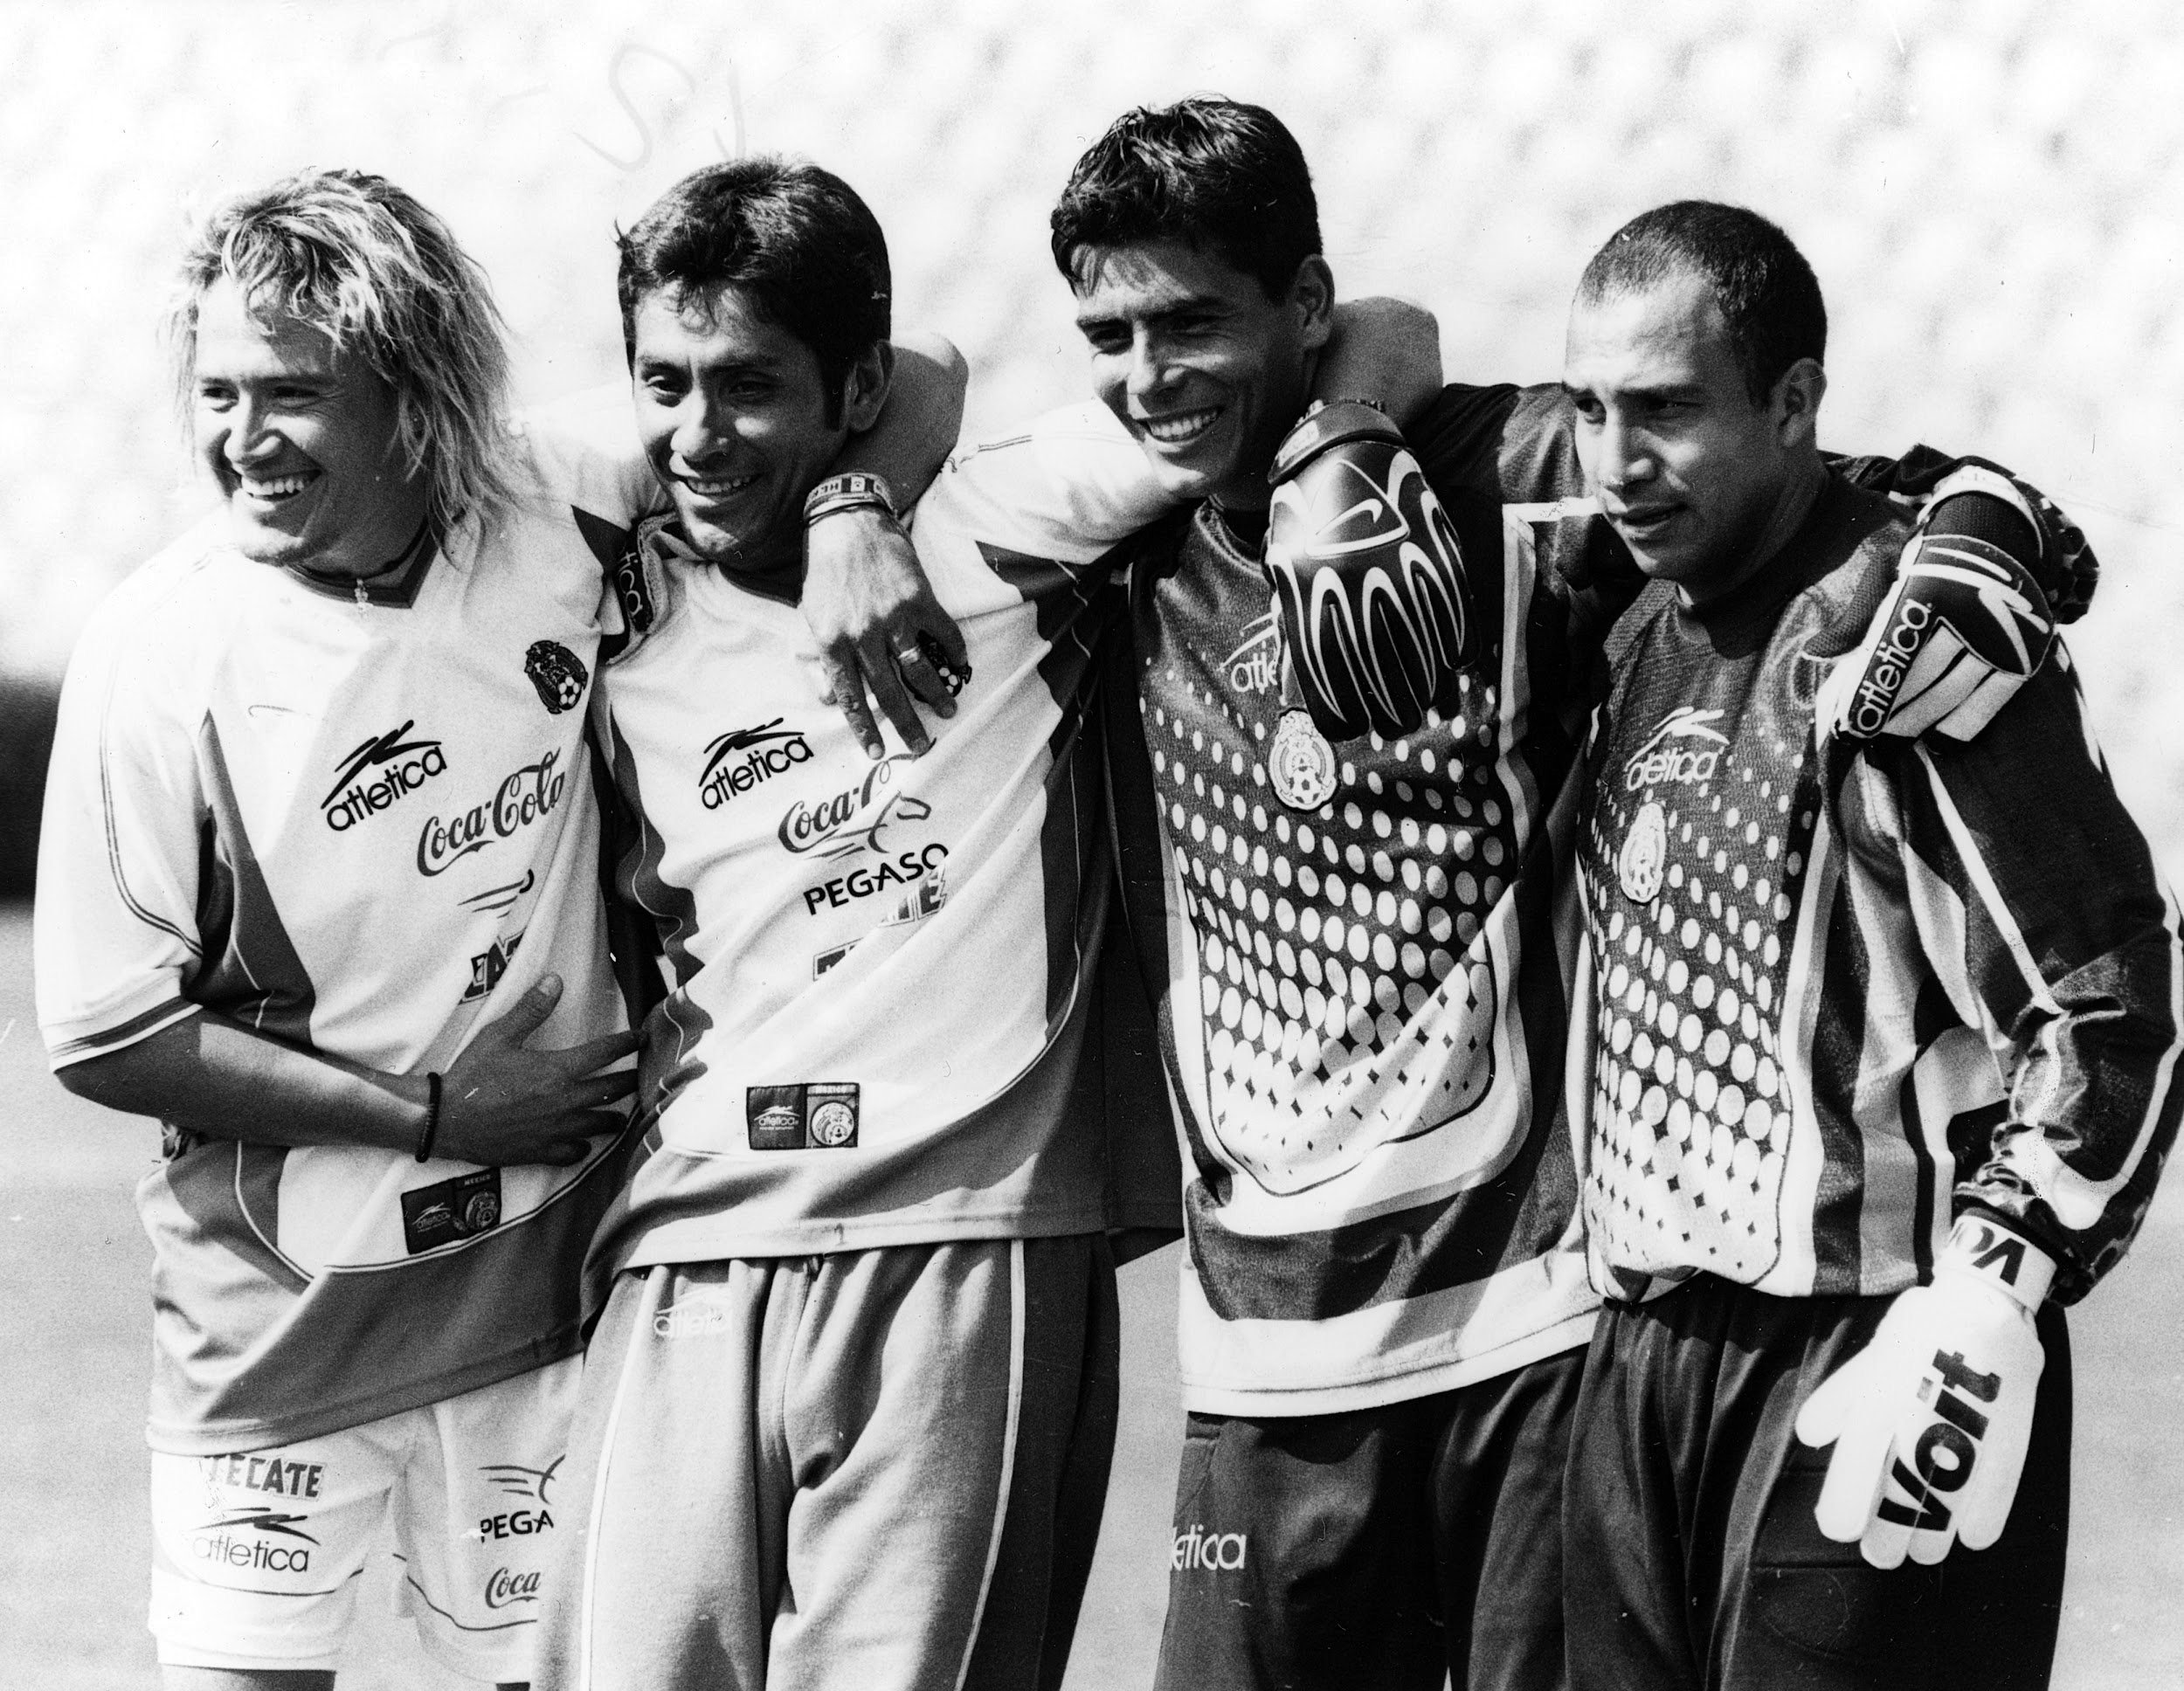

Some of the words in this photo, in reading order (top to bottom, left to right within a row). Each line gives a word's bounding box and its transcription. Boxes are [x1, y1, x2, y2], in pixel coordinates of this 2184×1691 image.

[1231, 652, 1279, 693] atle
[1856, 598, 1932, 730] atletica
[327, 746, 447, 831] atletica
[702, 736, 815, 810] atletica
[417, 747, 565, 877] Coca-Cola
[804, 843, 949, 916] PEGASO
[1877, 1349, 2002, 1532] Voit
[191, 1535, 310, 1572] atletica
[480, 1509, 554, 1543] PEGA
